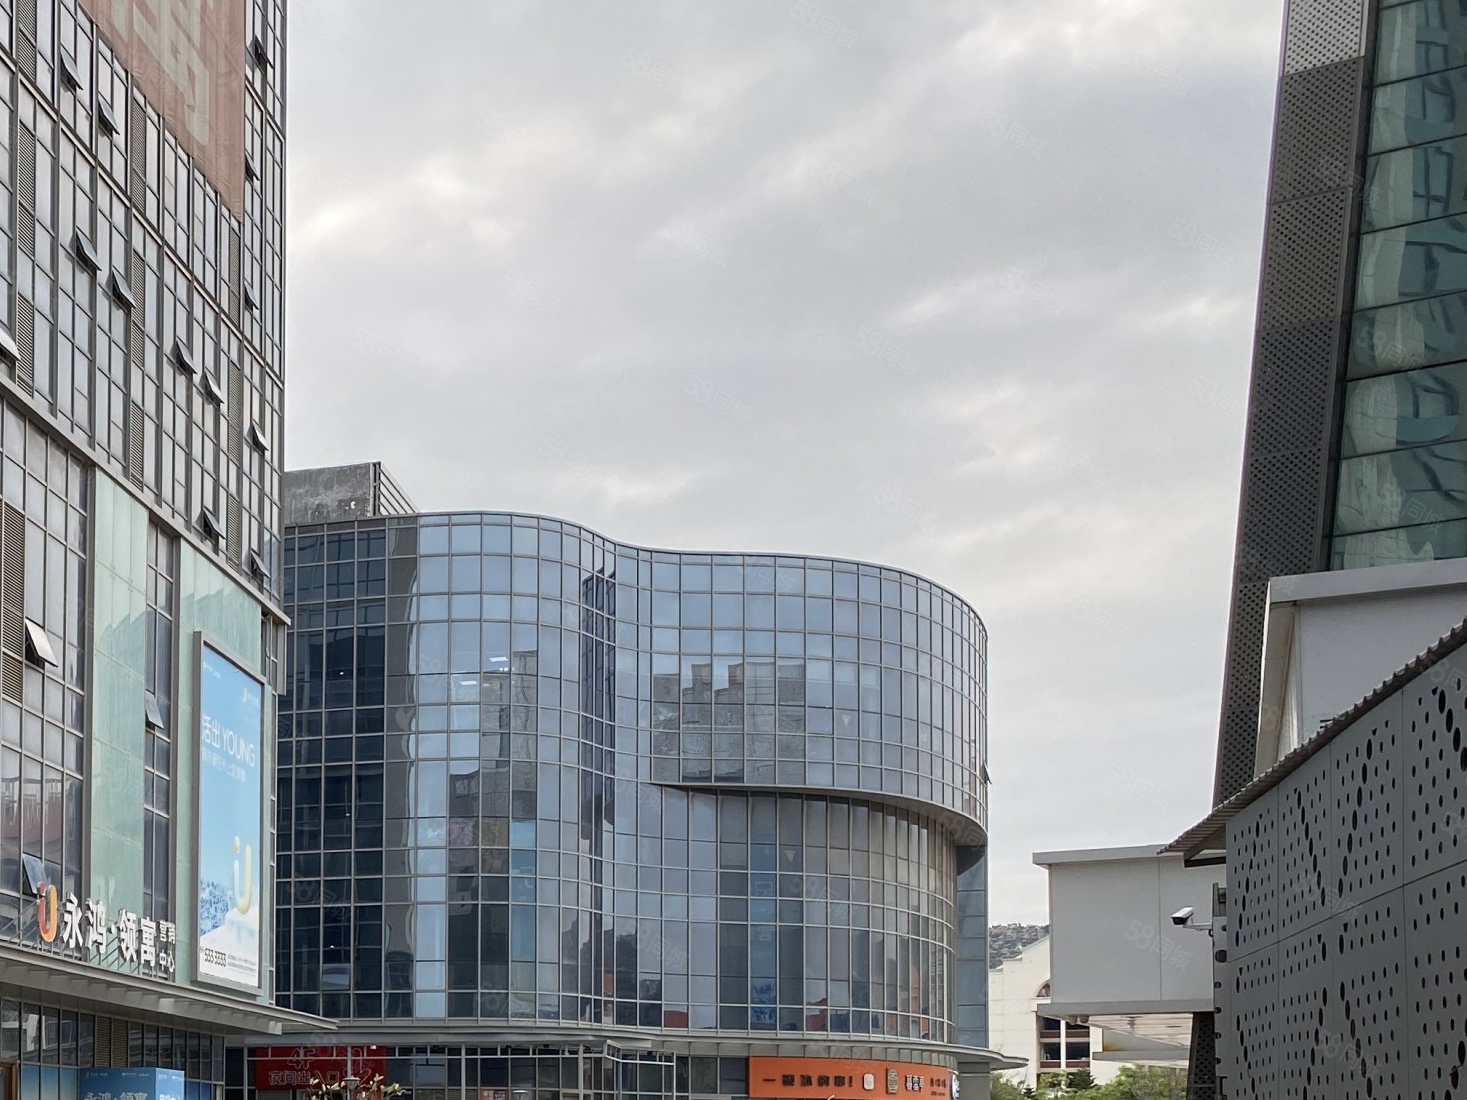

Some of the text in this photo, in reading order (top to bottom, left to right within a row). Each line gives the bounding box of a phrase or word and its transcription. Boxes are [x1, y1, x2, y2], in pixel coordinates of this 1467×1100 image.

[222, 727, 255, 768] YOUNG
[62, 892, 157, 967] 永鸿·领寓
